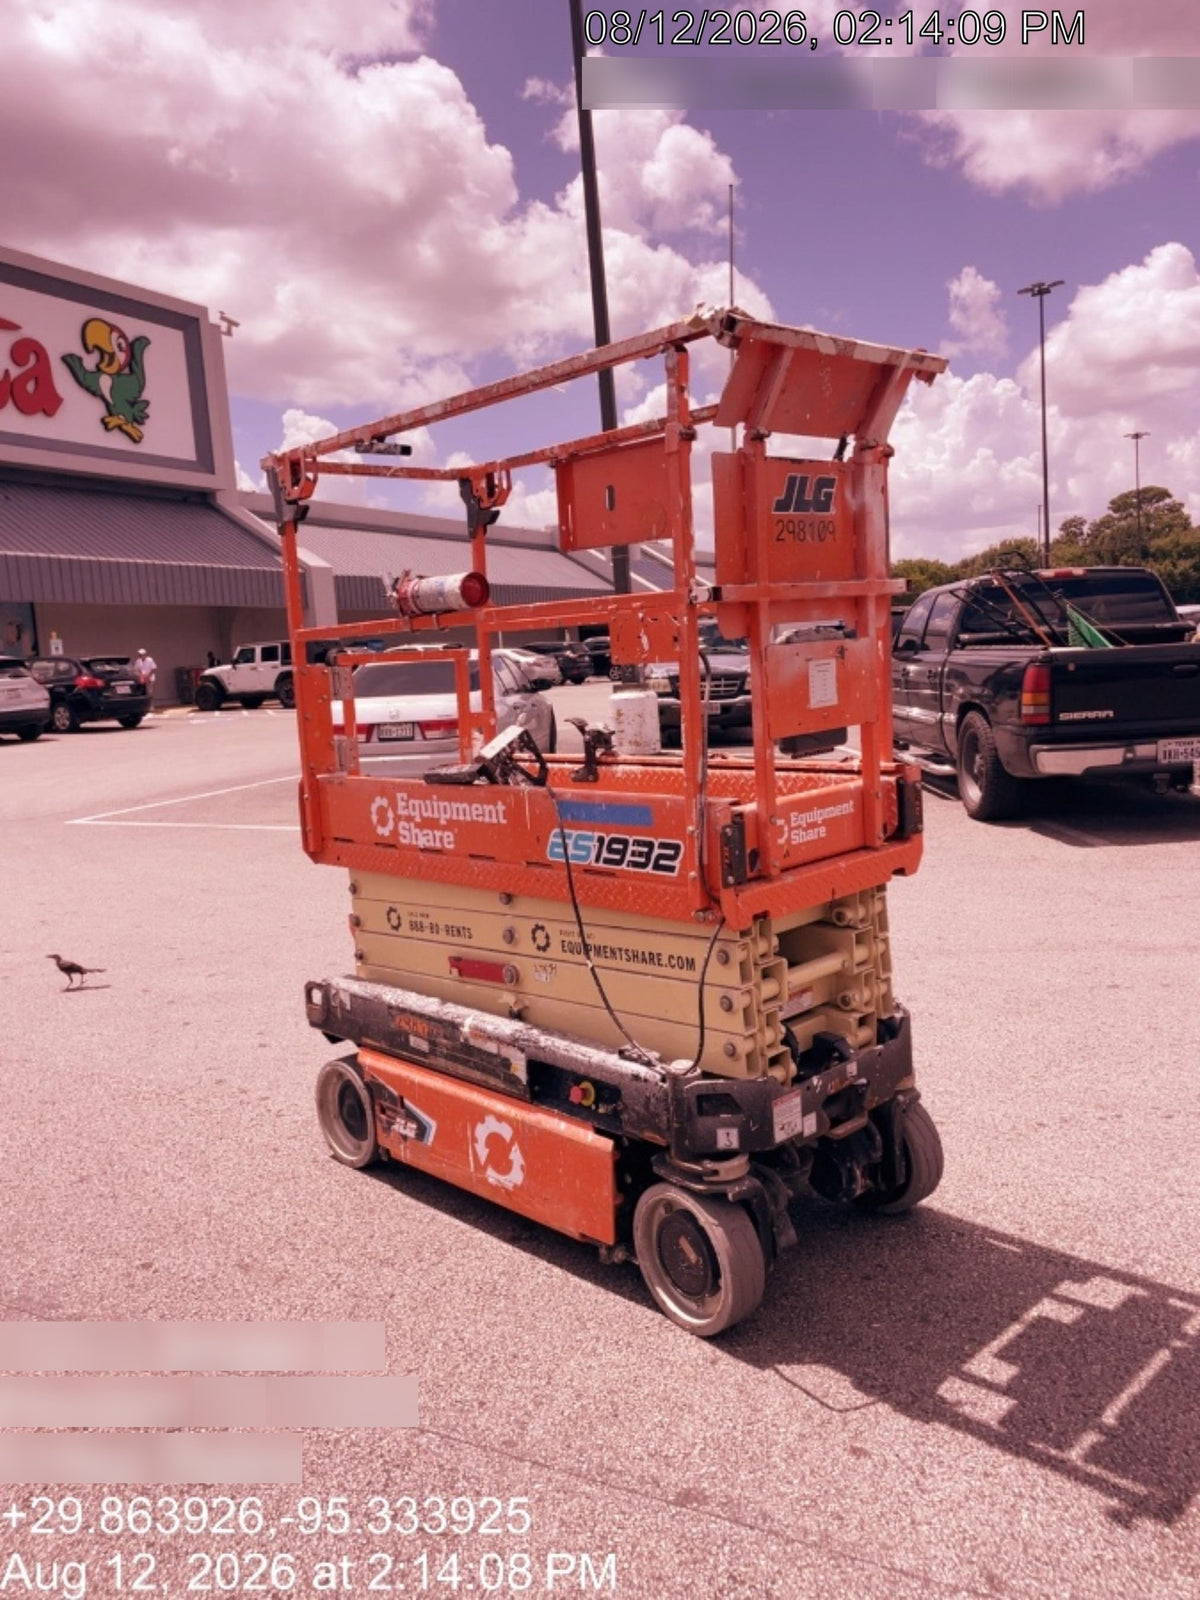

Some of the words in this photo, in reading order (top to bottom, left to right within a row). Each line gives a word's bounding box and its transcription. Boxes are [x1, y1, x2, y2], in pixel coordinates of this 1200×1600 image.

[771, 473, 838, 515] JLG
[1058, 710, 1114, 721] SIERRA
[396, 793, 507, 824] Equipment
[790, 800, 855, 827] Equipment
[399, 822, 456, 850] Share
[791, 826, 827, 845] Share
[547, 828, 684, 877] ES1932
